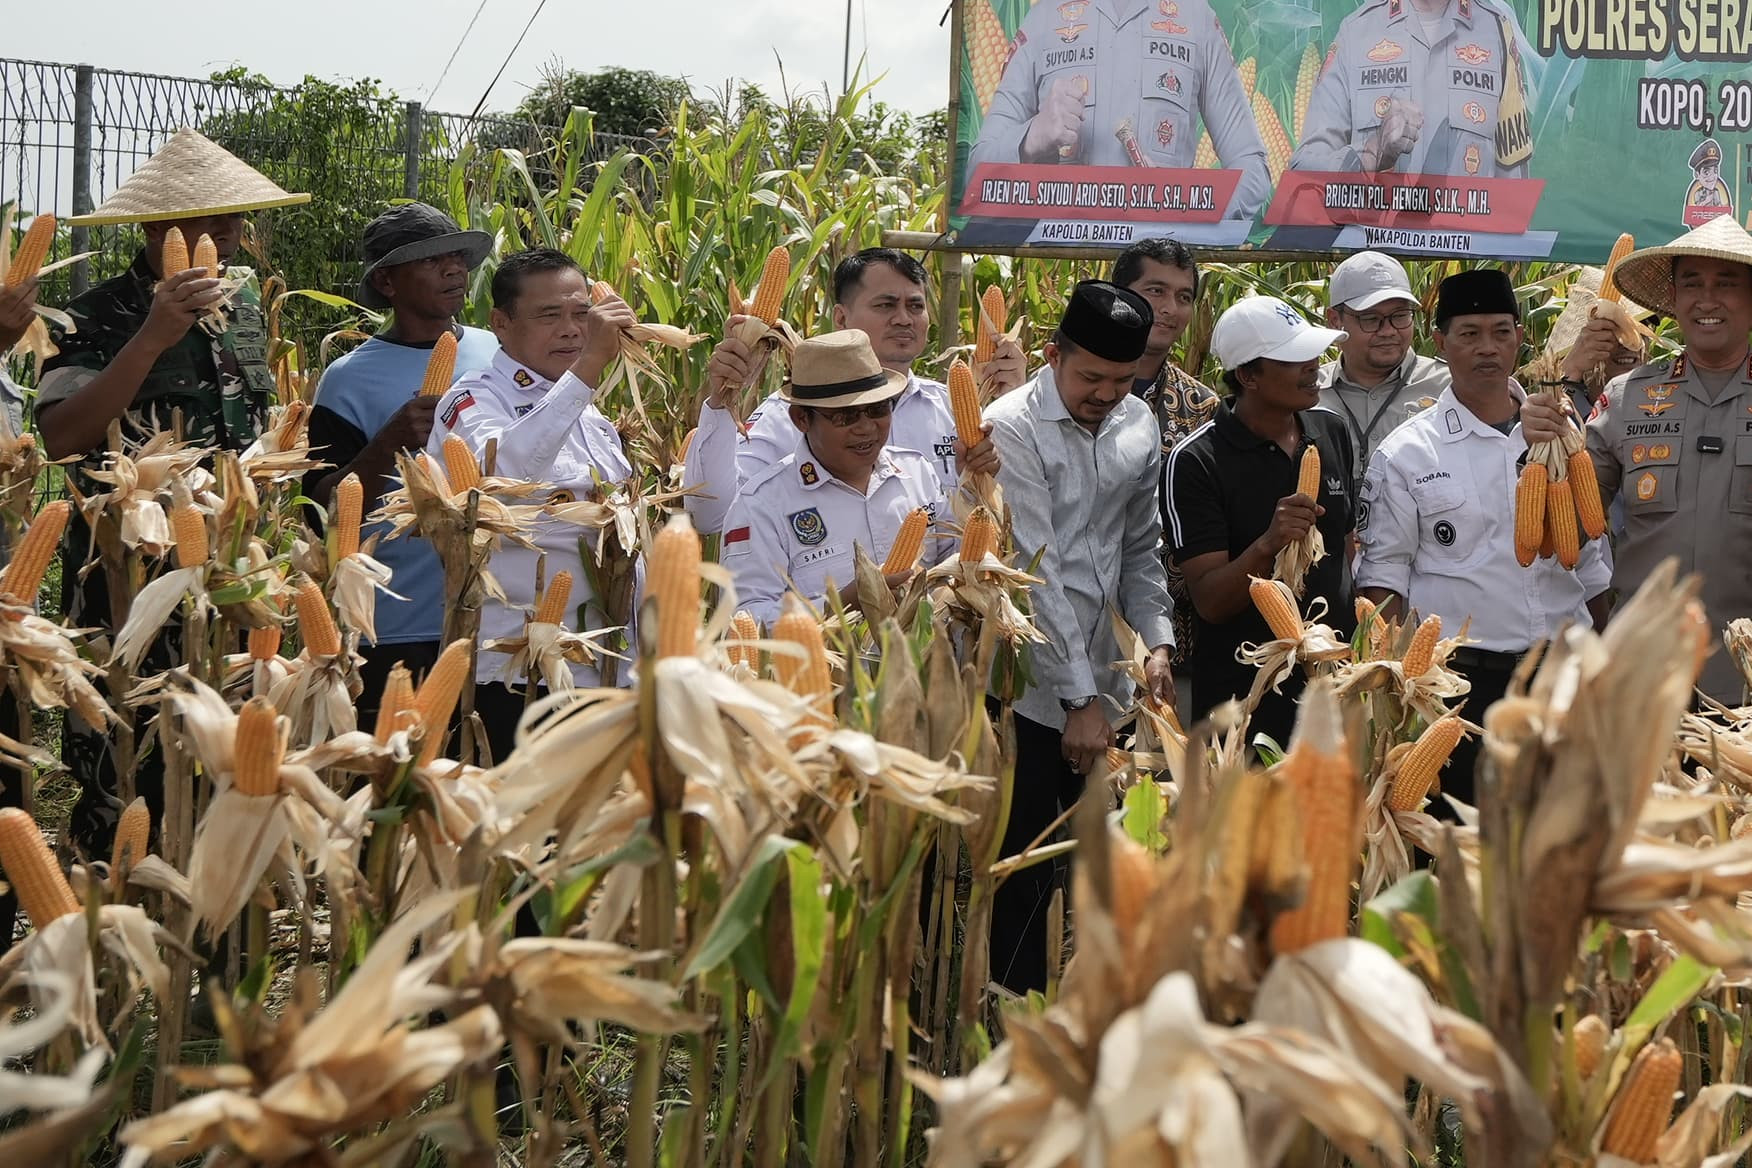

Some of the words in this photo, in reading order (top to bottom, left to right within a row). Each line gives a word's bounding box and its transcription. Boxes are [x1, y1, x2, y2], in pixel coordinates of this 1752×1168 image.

[1046, 48, 1077, 68] SUYUDI
[1080, 47, 1094, 61] A.S
[1150, 42, 1190, 63] POLRI
[1361, 66, 1408, 86] HENGKI
[1452, 70, 1494, 92] POLRI
[1639, 84, 1713, 134] KOPO,
[1720, 87, 1752, 130] 20
[1495, 111, 1530, 160] WAKA
[981, 180, 1011, 204] IRJEN
[1012, 182, 1034, 205] POL.
[1037, 182, 1072, 206] SUYUDI
[1074, 183, 1098, 207] ARIO
[1100, 184, 1128, 210] SETO,
[1130, 186, 1160, 210] S.I.K.,
[1162, 186, 1187, 211] S.H.,
[1189, 186, 1215, 210] M.SI.
[1325, 184, 1366, 208] BRIGJEN
[1368, 185, 1389, 210] POL.
[1392, 187, 1432, 214] HENGKI,
[1434, 190, 1464, 216] S.I.K.,
[1468, 190, 1490, 214] M.H.
[1041, 224, 1090, 240] KAPOLDA
[1092, 224, 1134, 241] BANTEN
[1365, 228, 1427, 248] WAKAPOLDA
[1430, 234, 1470, 251] BANTEN
[1626, 424, 1661, 436] SUYUDI
[1664, 422, 1680, 433] A.S
[1416, 472, 1450, 484] SOBARI
[804, 547, 834, 562] SAFRI
